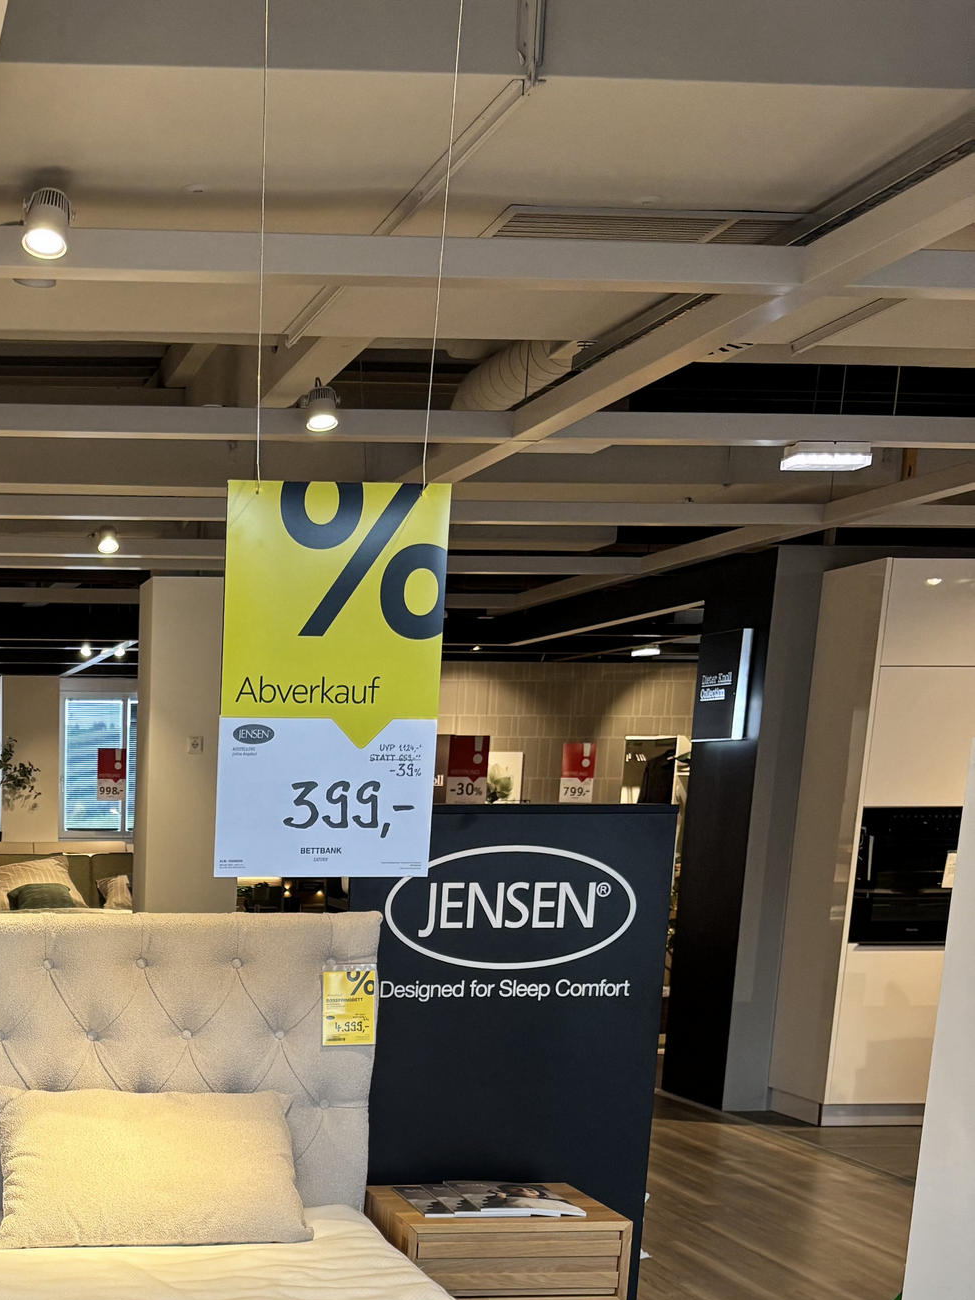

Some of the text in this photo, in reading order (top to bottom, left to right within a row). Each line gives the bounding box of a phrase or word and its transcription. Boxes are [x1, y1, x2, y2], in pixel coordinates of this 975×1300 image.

[235, 676, 380, 704] Abverkauf
[238, 728, 270, 740] JENSEN
[379, 743, 396, 752] UVP
[369, 753, 396, 762] STATT
[389, 763, 422, 777] -39%
[450, 782, 483, 796] -30%
[283, 780, 415, 839] 399,-
[300, 847, 342, 855] BETTBANK
[380, 979, 631, 1002] Designed for Sleep Comfort
[334, 1021, 370, 1033] 4.999,-
